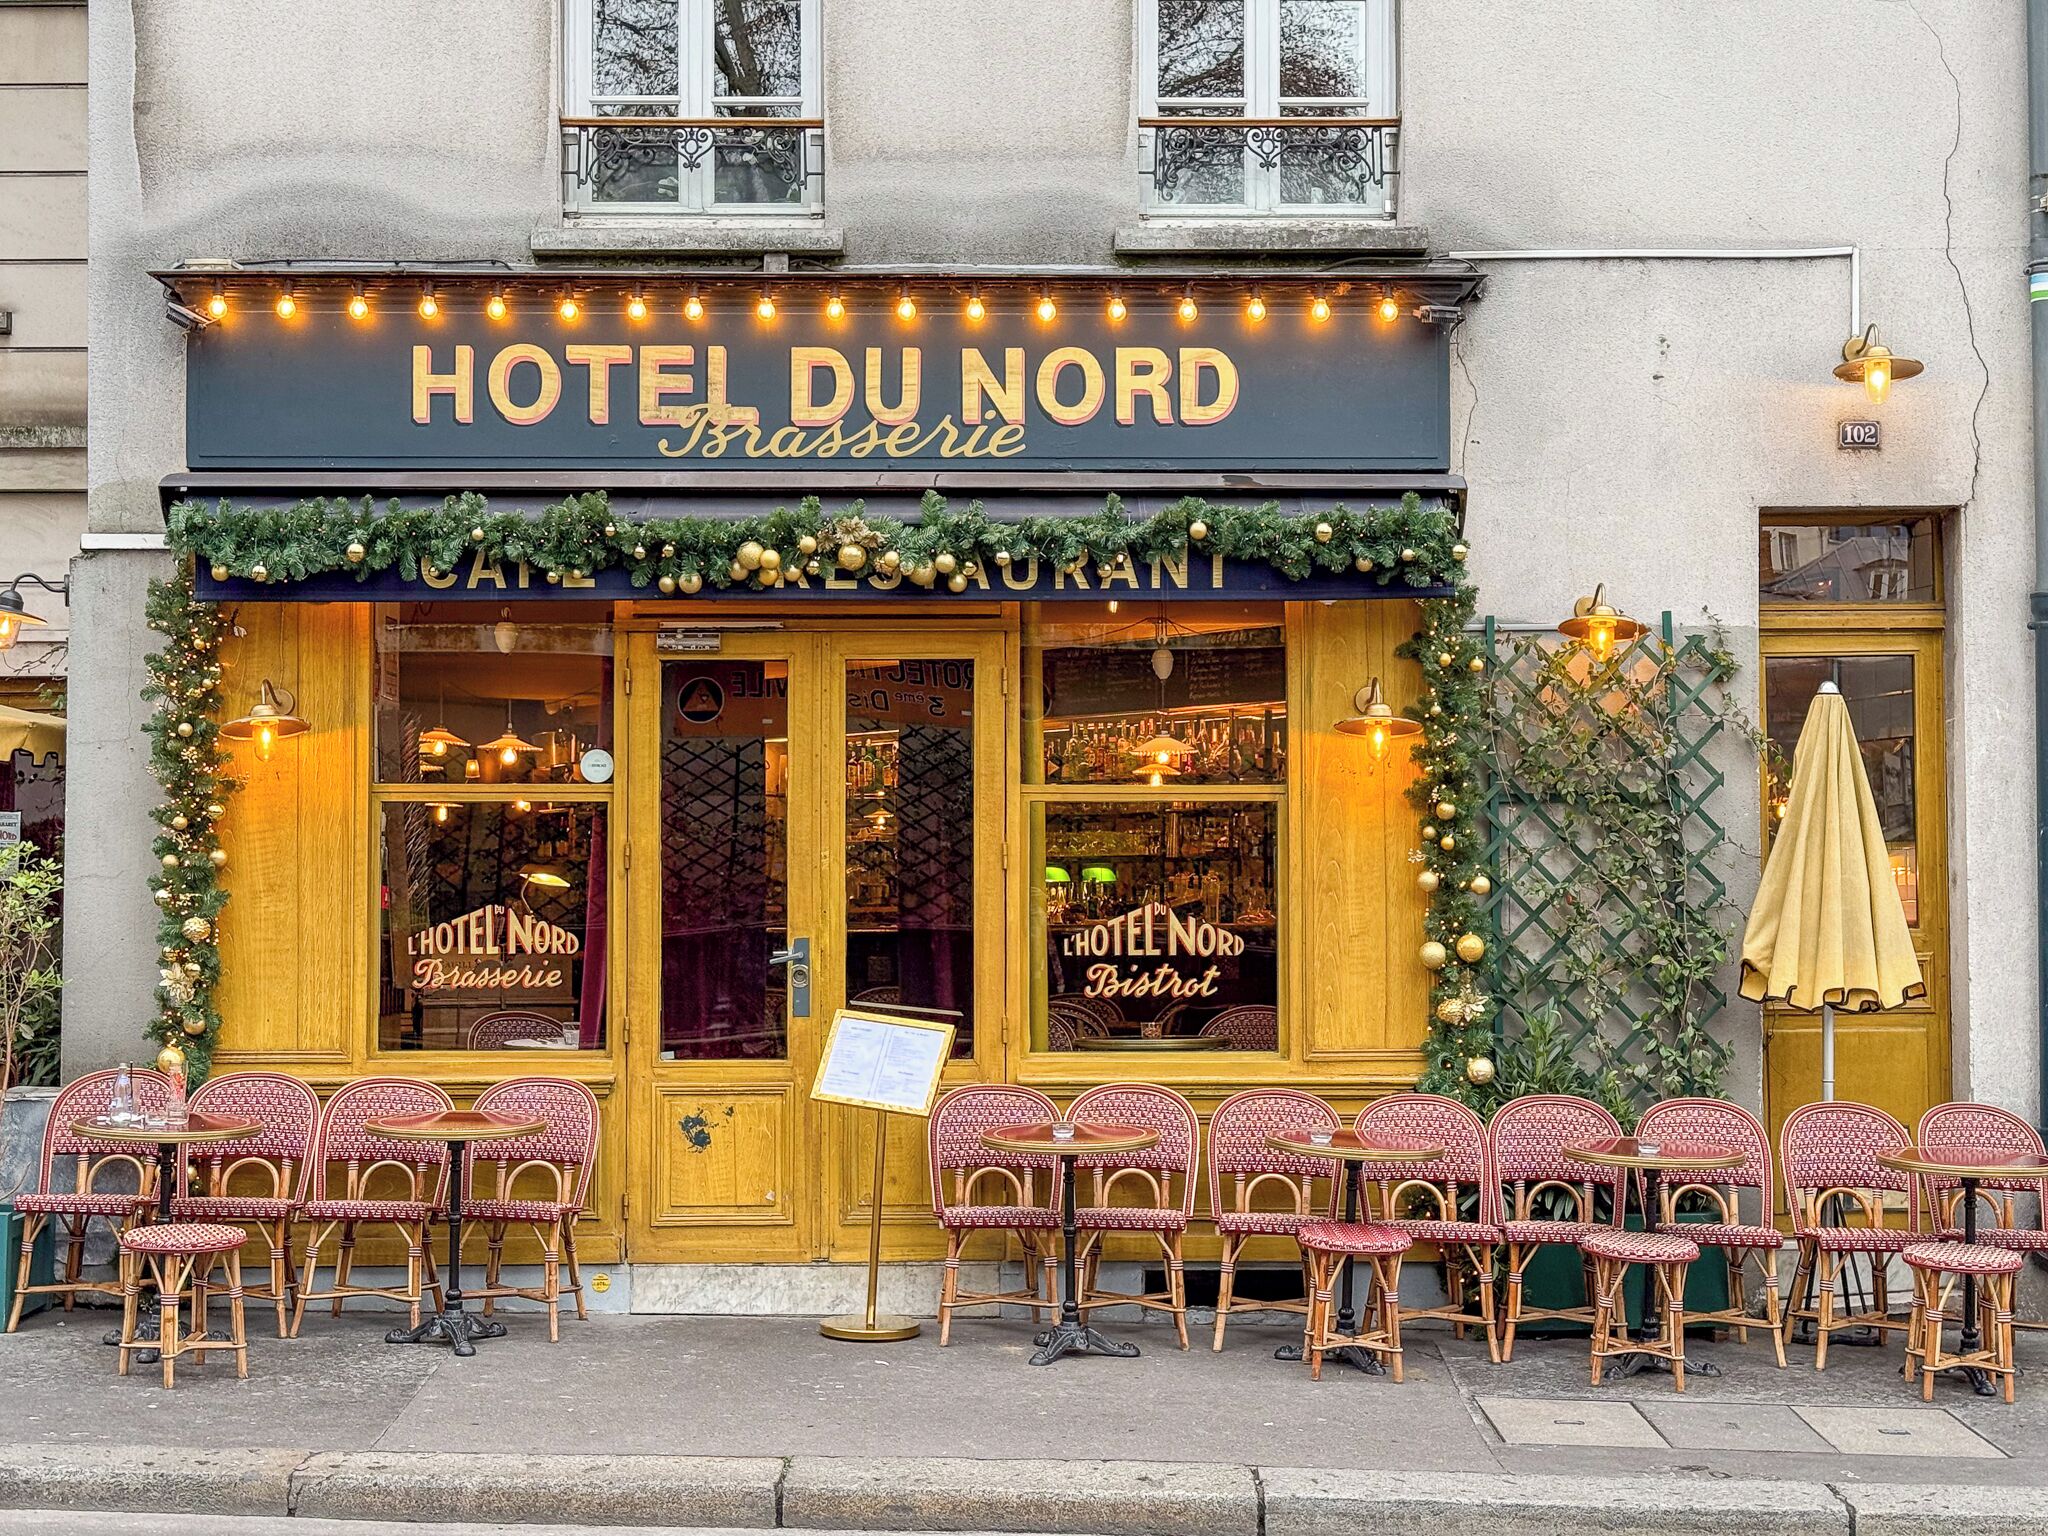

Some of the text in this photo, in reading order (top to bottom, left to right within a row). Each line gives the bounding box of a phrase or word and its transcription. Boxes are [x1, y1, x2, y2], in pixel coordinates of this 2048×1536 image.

[411, 344, 1240, 426] HOTEL DU NORD
[657, 401, 1029, 459] Brasserie
[1844, 424, 1876, 444] 102
[407, 904, 580, 956] L'HOTEL DU NORD
[1063, 902, 1246, 957] L'HOTEL DU NORD
[411, 957, 563, 989] Brasserie
[1083, 963, 1221, 999] Bistrot
